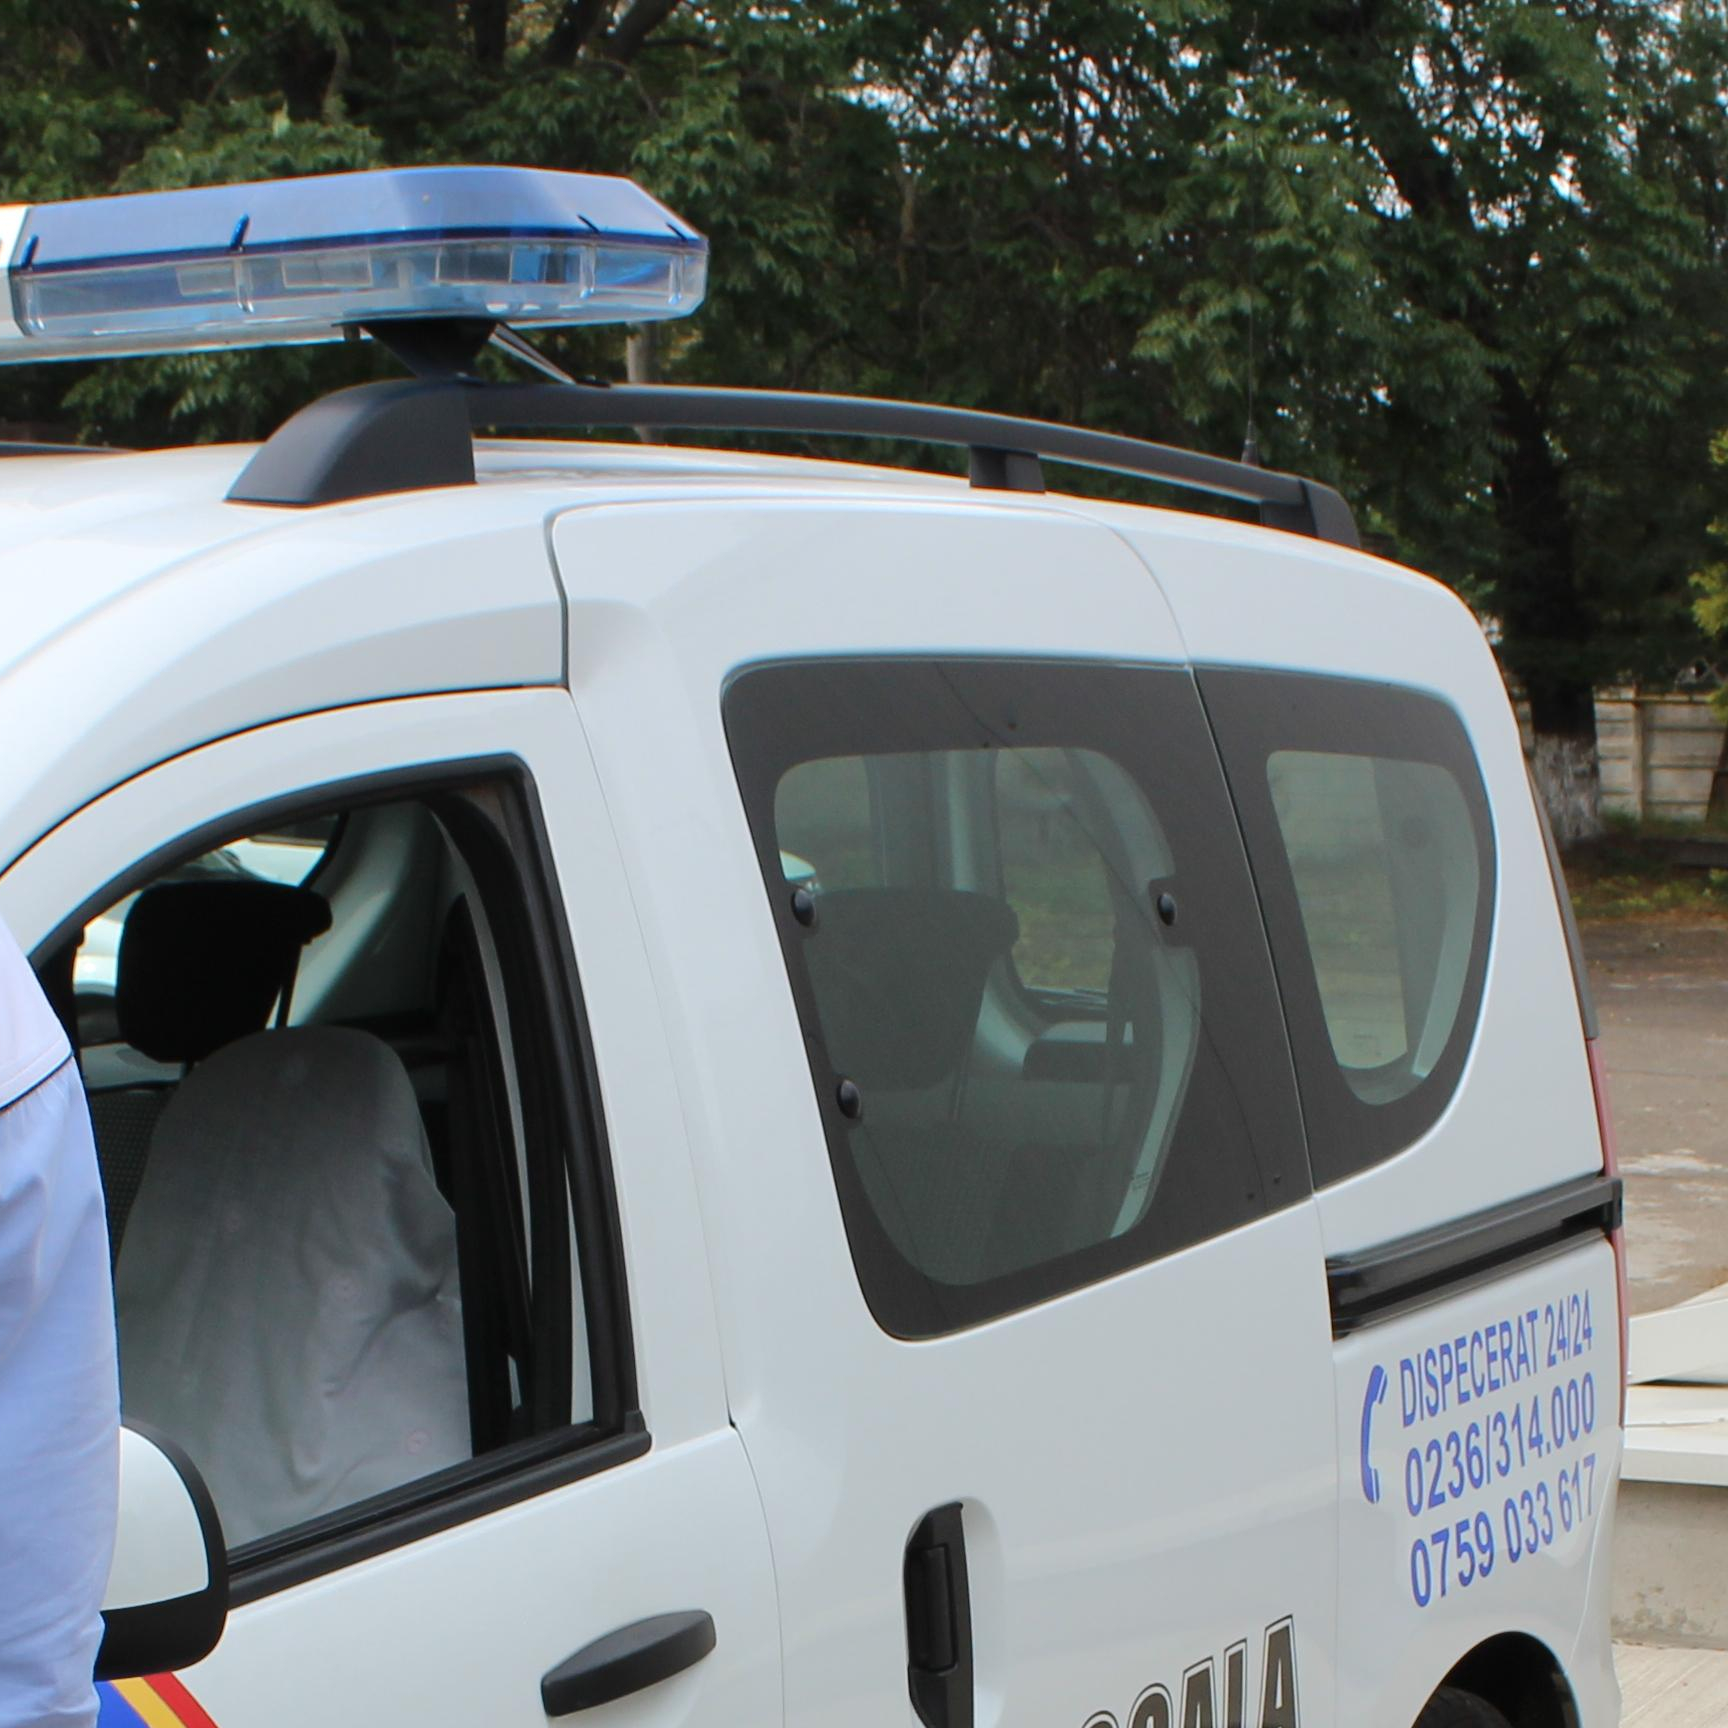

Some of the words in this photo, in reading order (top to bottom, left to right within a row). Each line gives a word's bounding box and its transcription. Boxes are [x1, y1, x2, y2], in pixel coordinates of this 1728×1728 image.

[1399, 1308, 1539, 1428] DISPECERAT
[1544, 1289, 1593, 1369] 24/24
[1405, 1371, 1595, 1518] 0236/314.000
[1410, 1510, 1495, 1608] 0759
[1503, 1481, 1554, 1565] 033
[1557, 1452, 1597, 1533] 617
